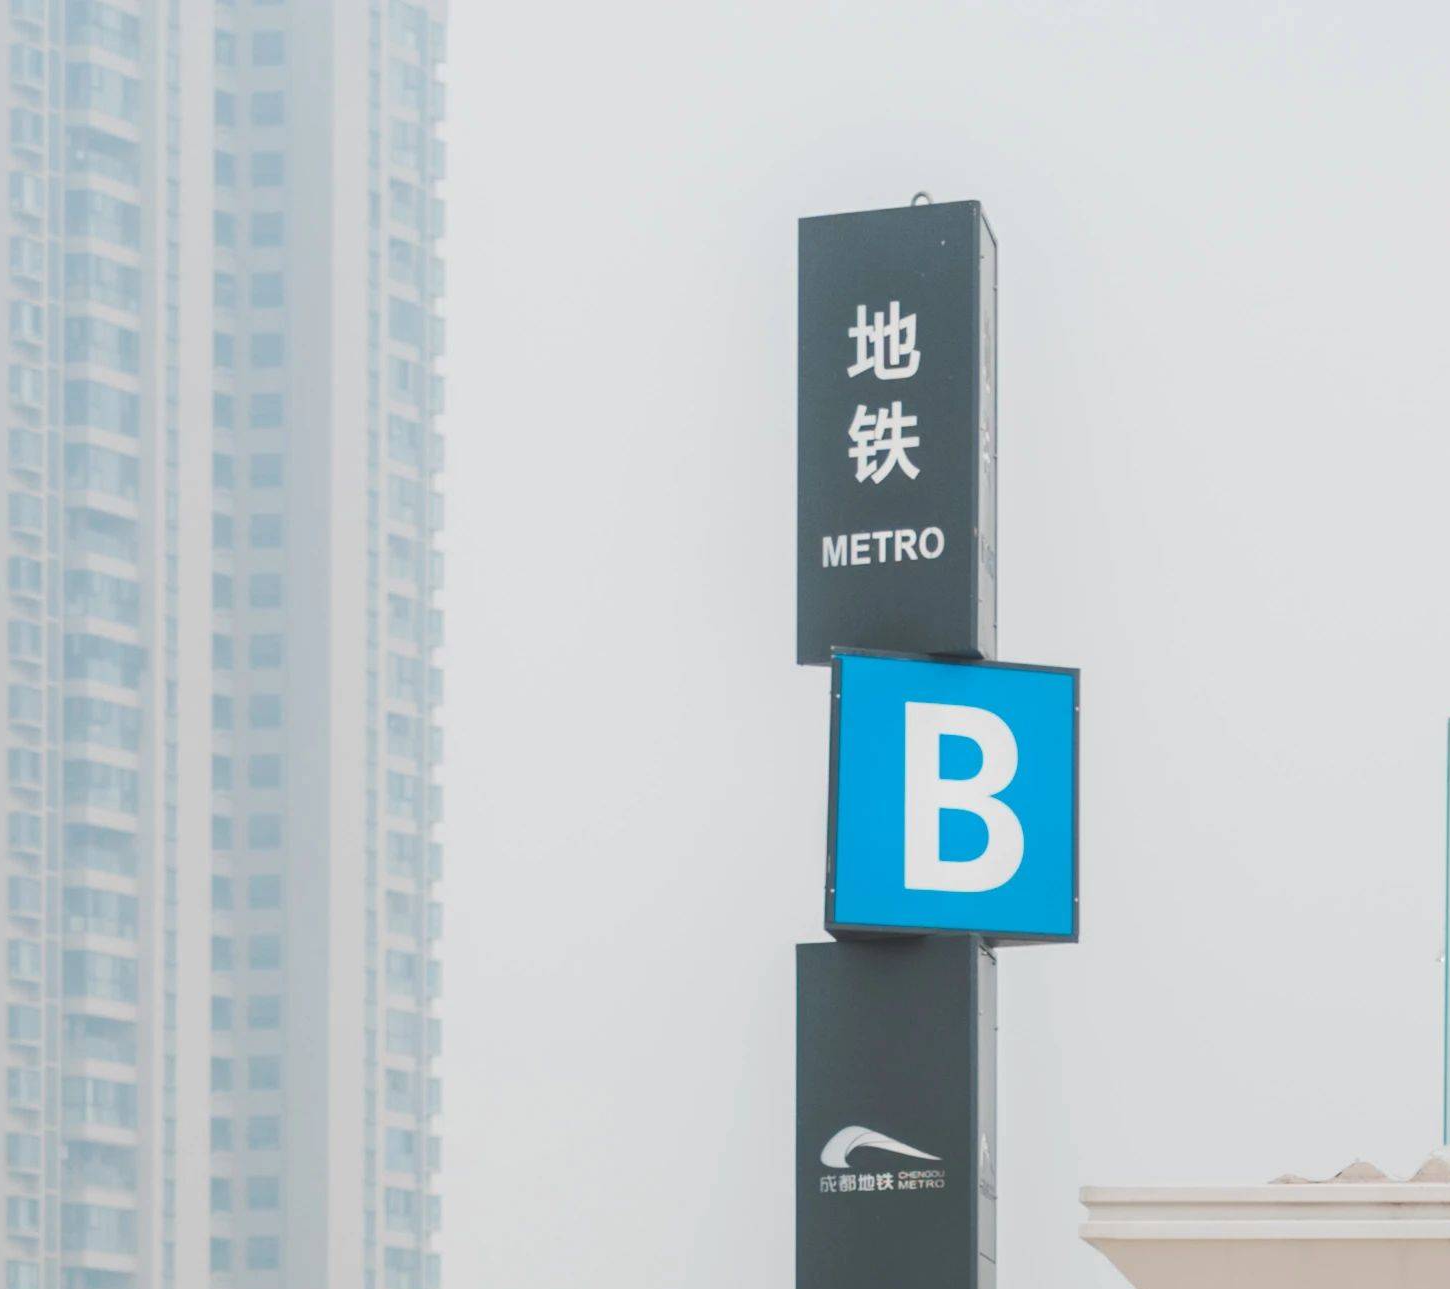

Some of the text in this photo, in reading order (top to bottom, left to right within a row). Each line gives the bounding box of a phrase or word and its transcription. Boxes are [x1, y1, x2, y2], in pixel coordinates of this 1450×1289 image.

[847, 301, 921, 484] 地铁
[822, 526, 946, 568] METRO
[904, 701, 1025, 893] B
[819, 1172, 895, 1194] 成都地铁
[898, 1178, 946, 1190] METRO
